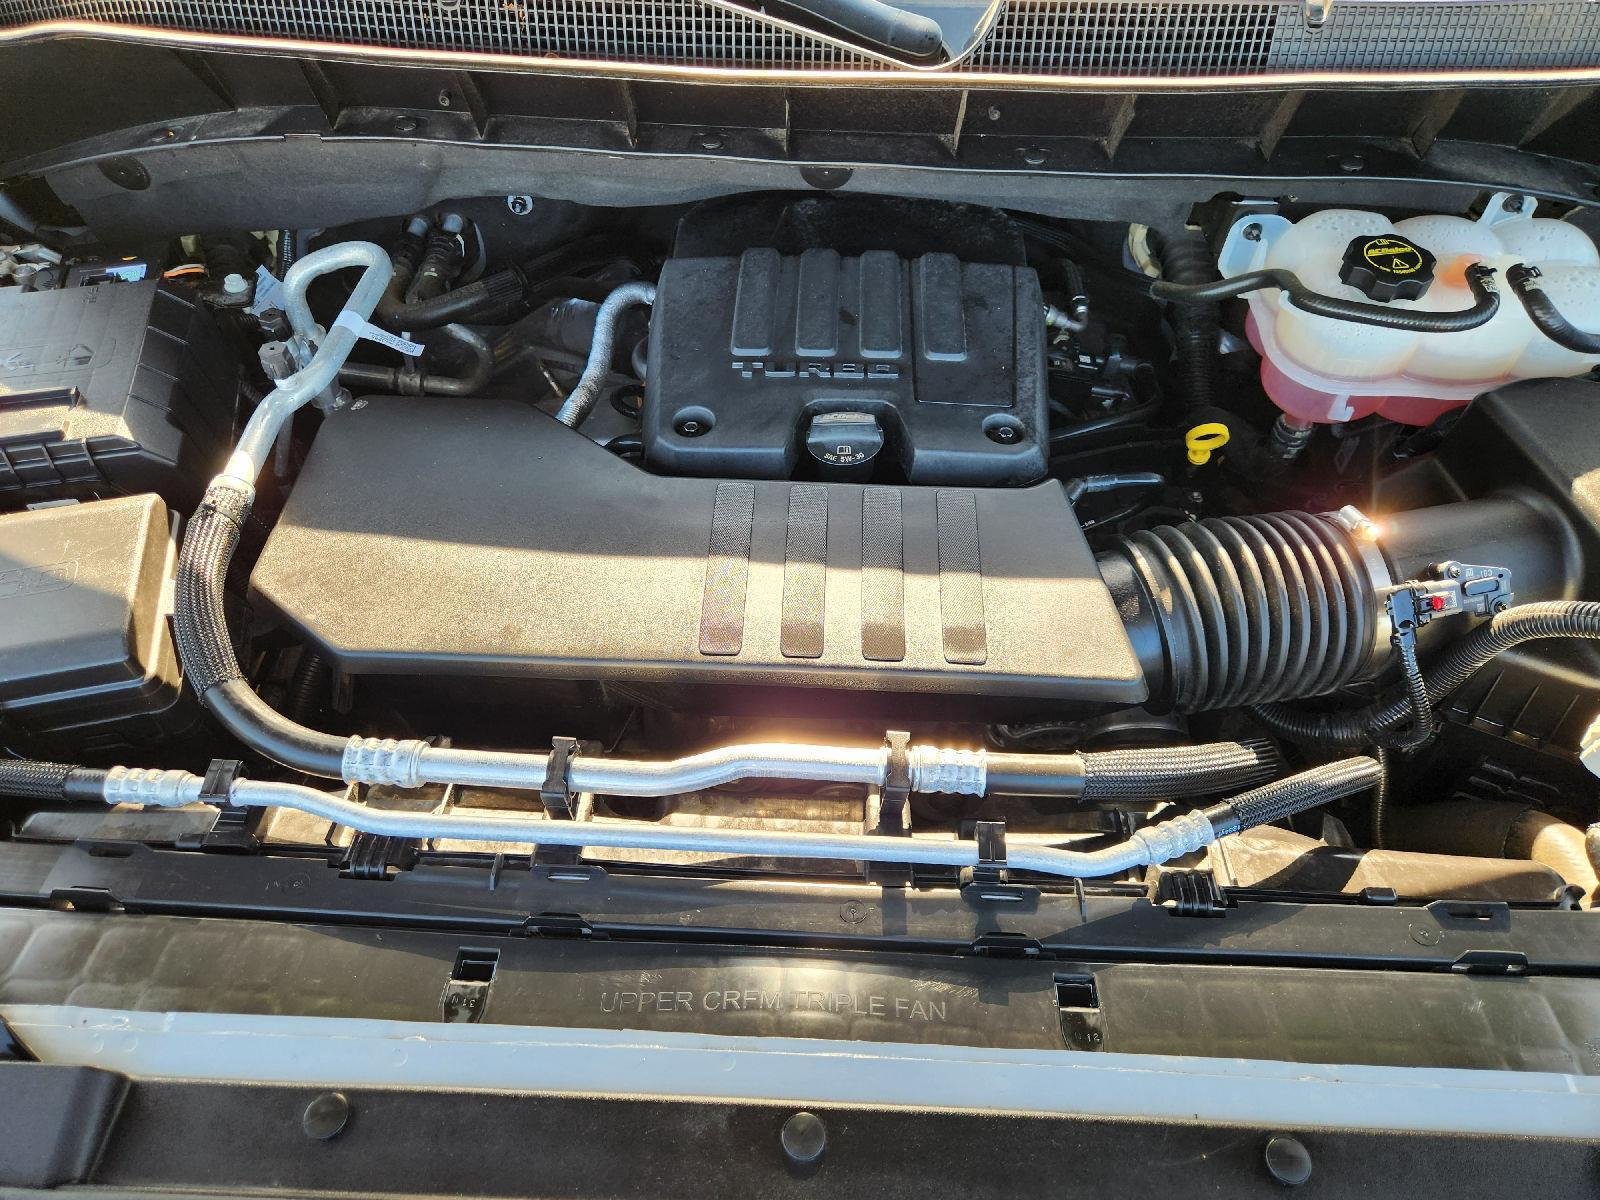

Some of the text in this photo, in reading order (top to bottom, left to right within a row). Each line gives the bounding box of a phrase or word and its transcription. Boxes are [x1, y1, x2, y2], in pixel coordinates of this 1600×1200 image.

[823, 452, 865, 463] SAE 5W-30
[600, 990, 947, 1022] UPPER CRFM TRIPLE FAN
